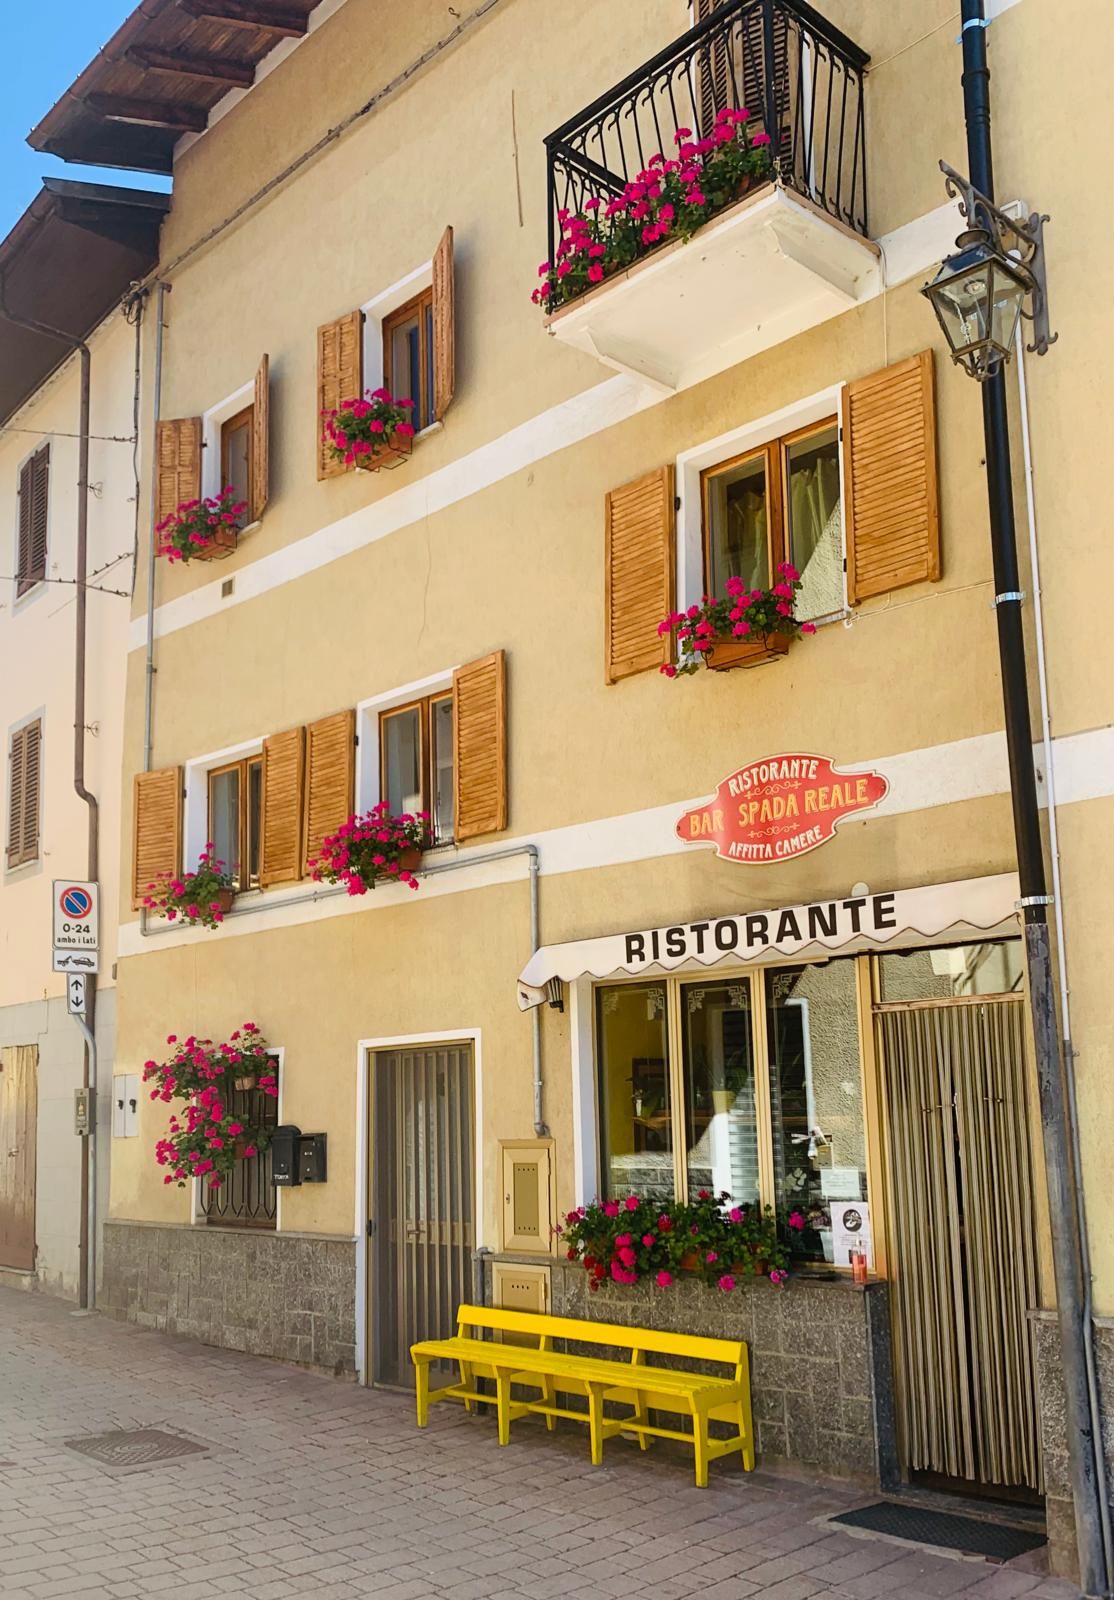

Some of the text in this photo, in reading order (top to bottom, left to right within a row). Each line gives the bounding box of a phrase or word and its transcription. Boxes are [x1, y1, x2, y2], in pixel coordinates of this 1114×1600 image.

[728, 759, 819, 797] RISTORANTE
[689, 778, 869, 838] BAR SPADA REALE
[728, 825, 823, 860] AFFITTA CAMERE
[625, 893, 897, 964] RISTORANTE
